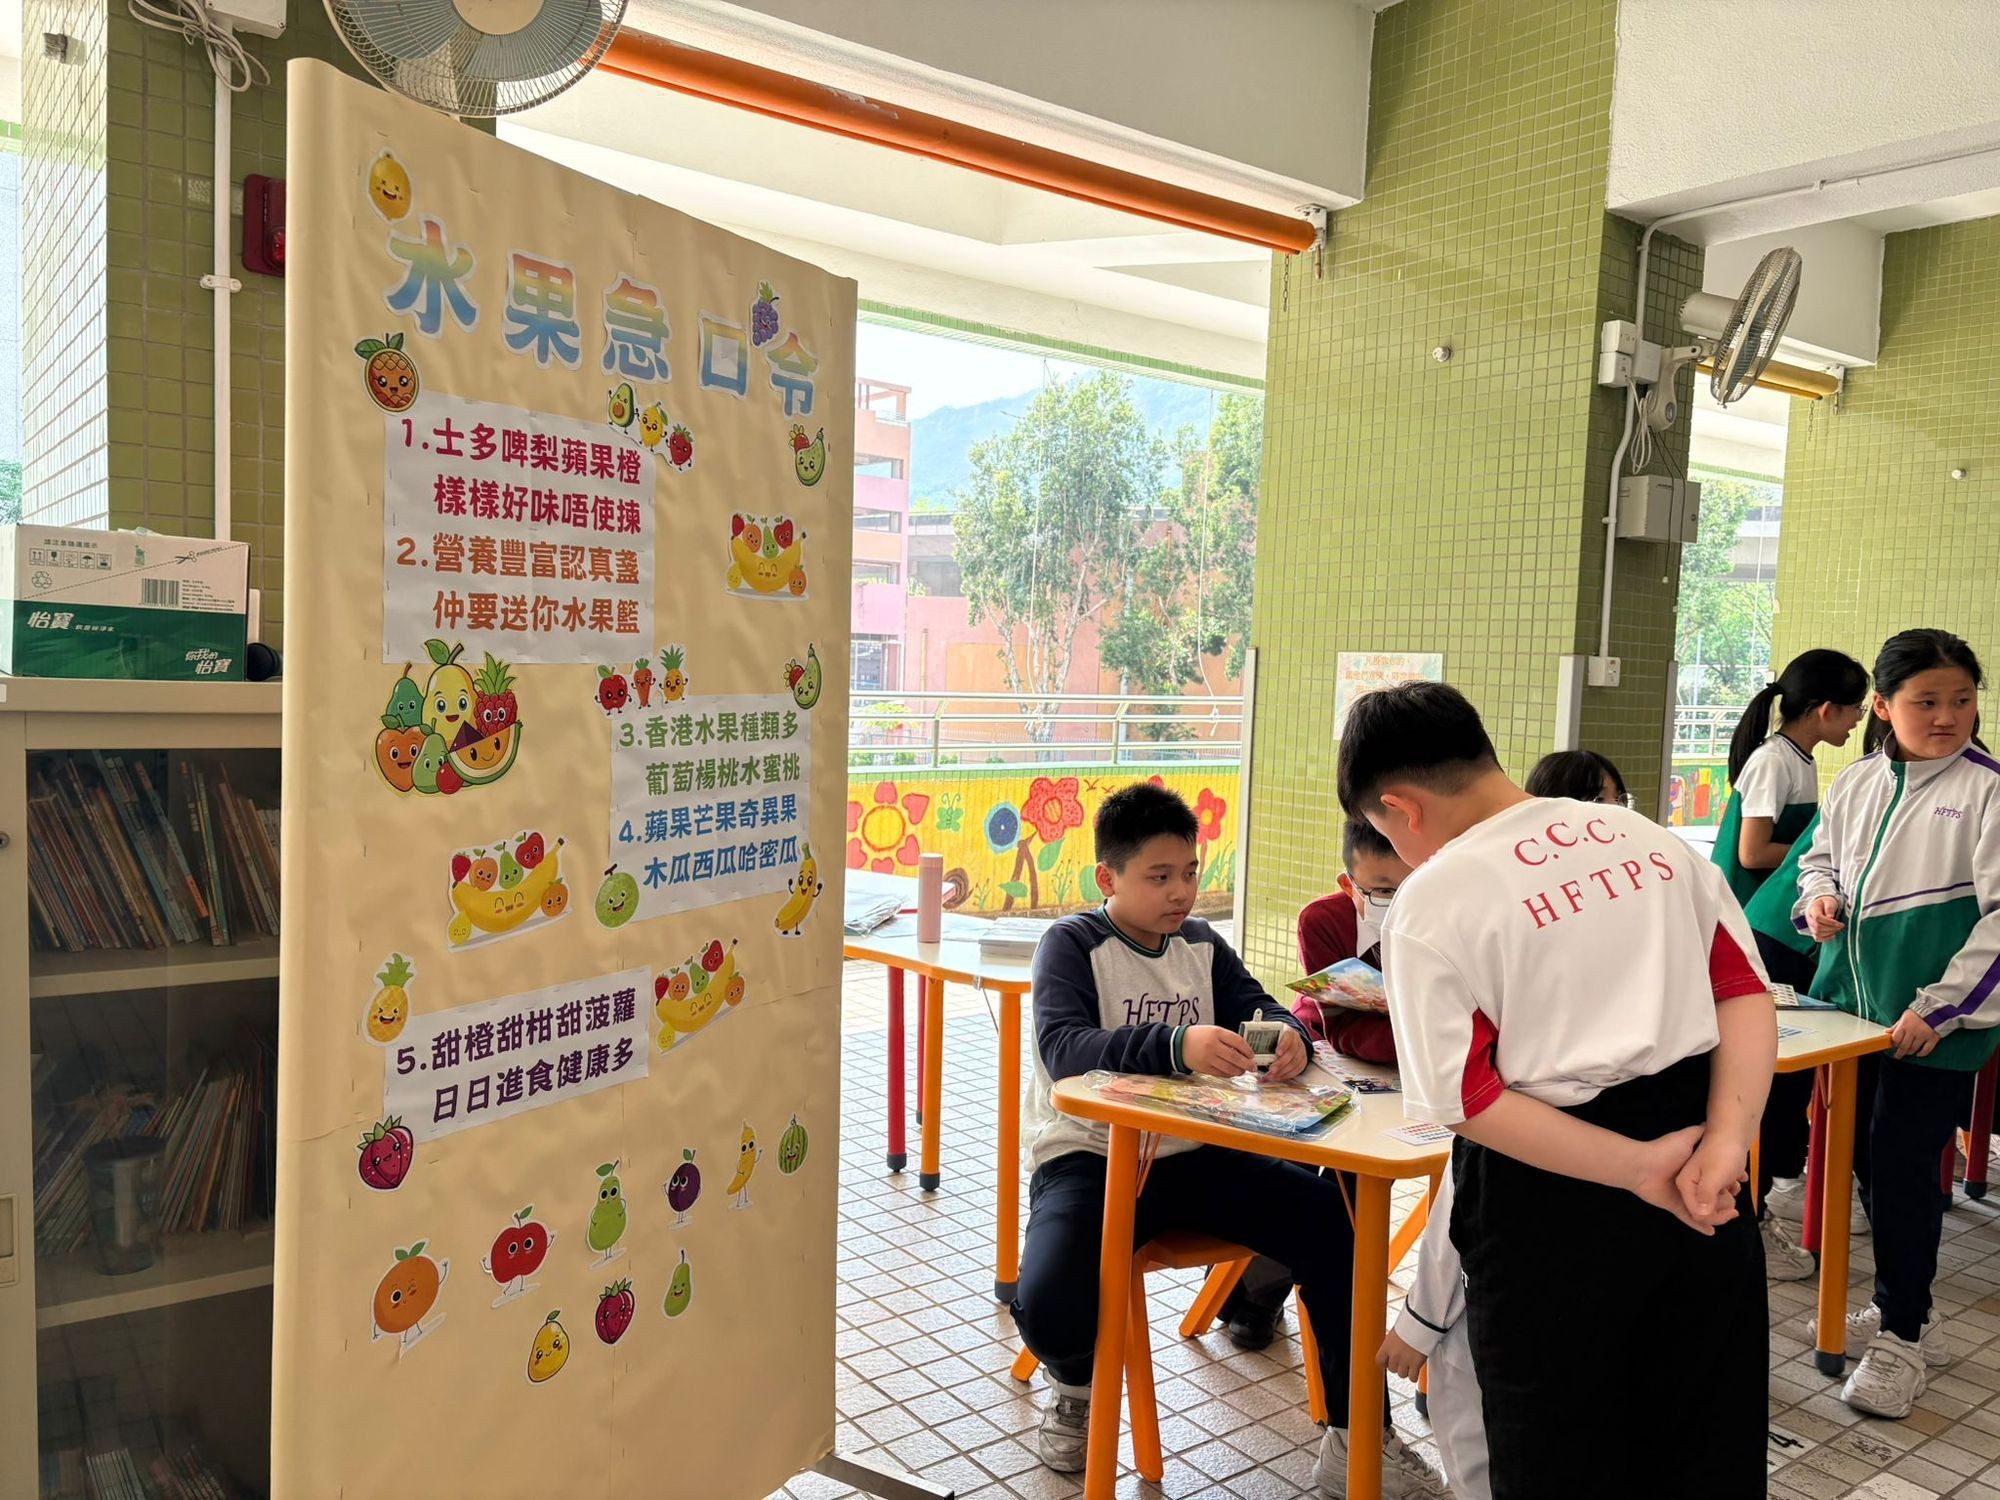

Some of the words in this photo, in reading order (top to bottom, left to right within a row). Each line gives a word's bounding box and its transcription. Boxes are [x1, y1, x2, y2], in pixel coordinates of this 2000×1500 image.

[386, 219, 819, 417] 水果急口令
[401, 417, 641, 485] 1.士多啤梨蘋果橙
[433, 474, 642, 535] 樣樣好味唔使揀
[396, 532, 640, 585] 2.營養豐富認真盞
[27, 611, 75, 630] 怡寶
[433, 590, 640, 634] 仲要送你水果籃
[619, 710, 799, 748] 3.香港水果種類多
[645, 752, 800, 796] 葡萄楊桃水蜜桃
[618, 793, 797, 843] 4.蘋果芒果奇異果
[643, 835, 798, 889] 木瓜西瓜哈密瓜
[1522, 852, 1674, 929] HFTPS
[396, 987, 637, 1075] 5.甜橙甜柑甜菠蘿
[1123, 992, 1200, 1026] HFTPS
[433, 1037, 634, 1123] 日日進食健康多
